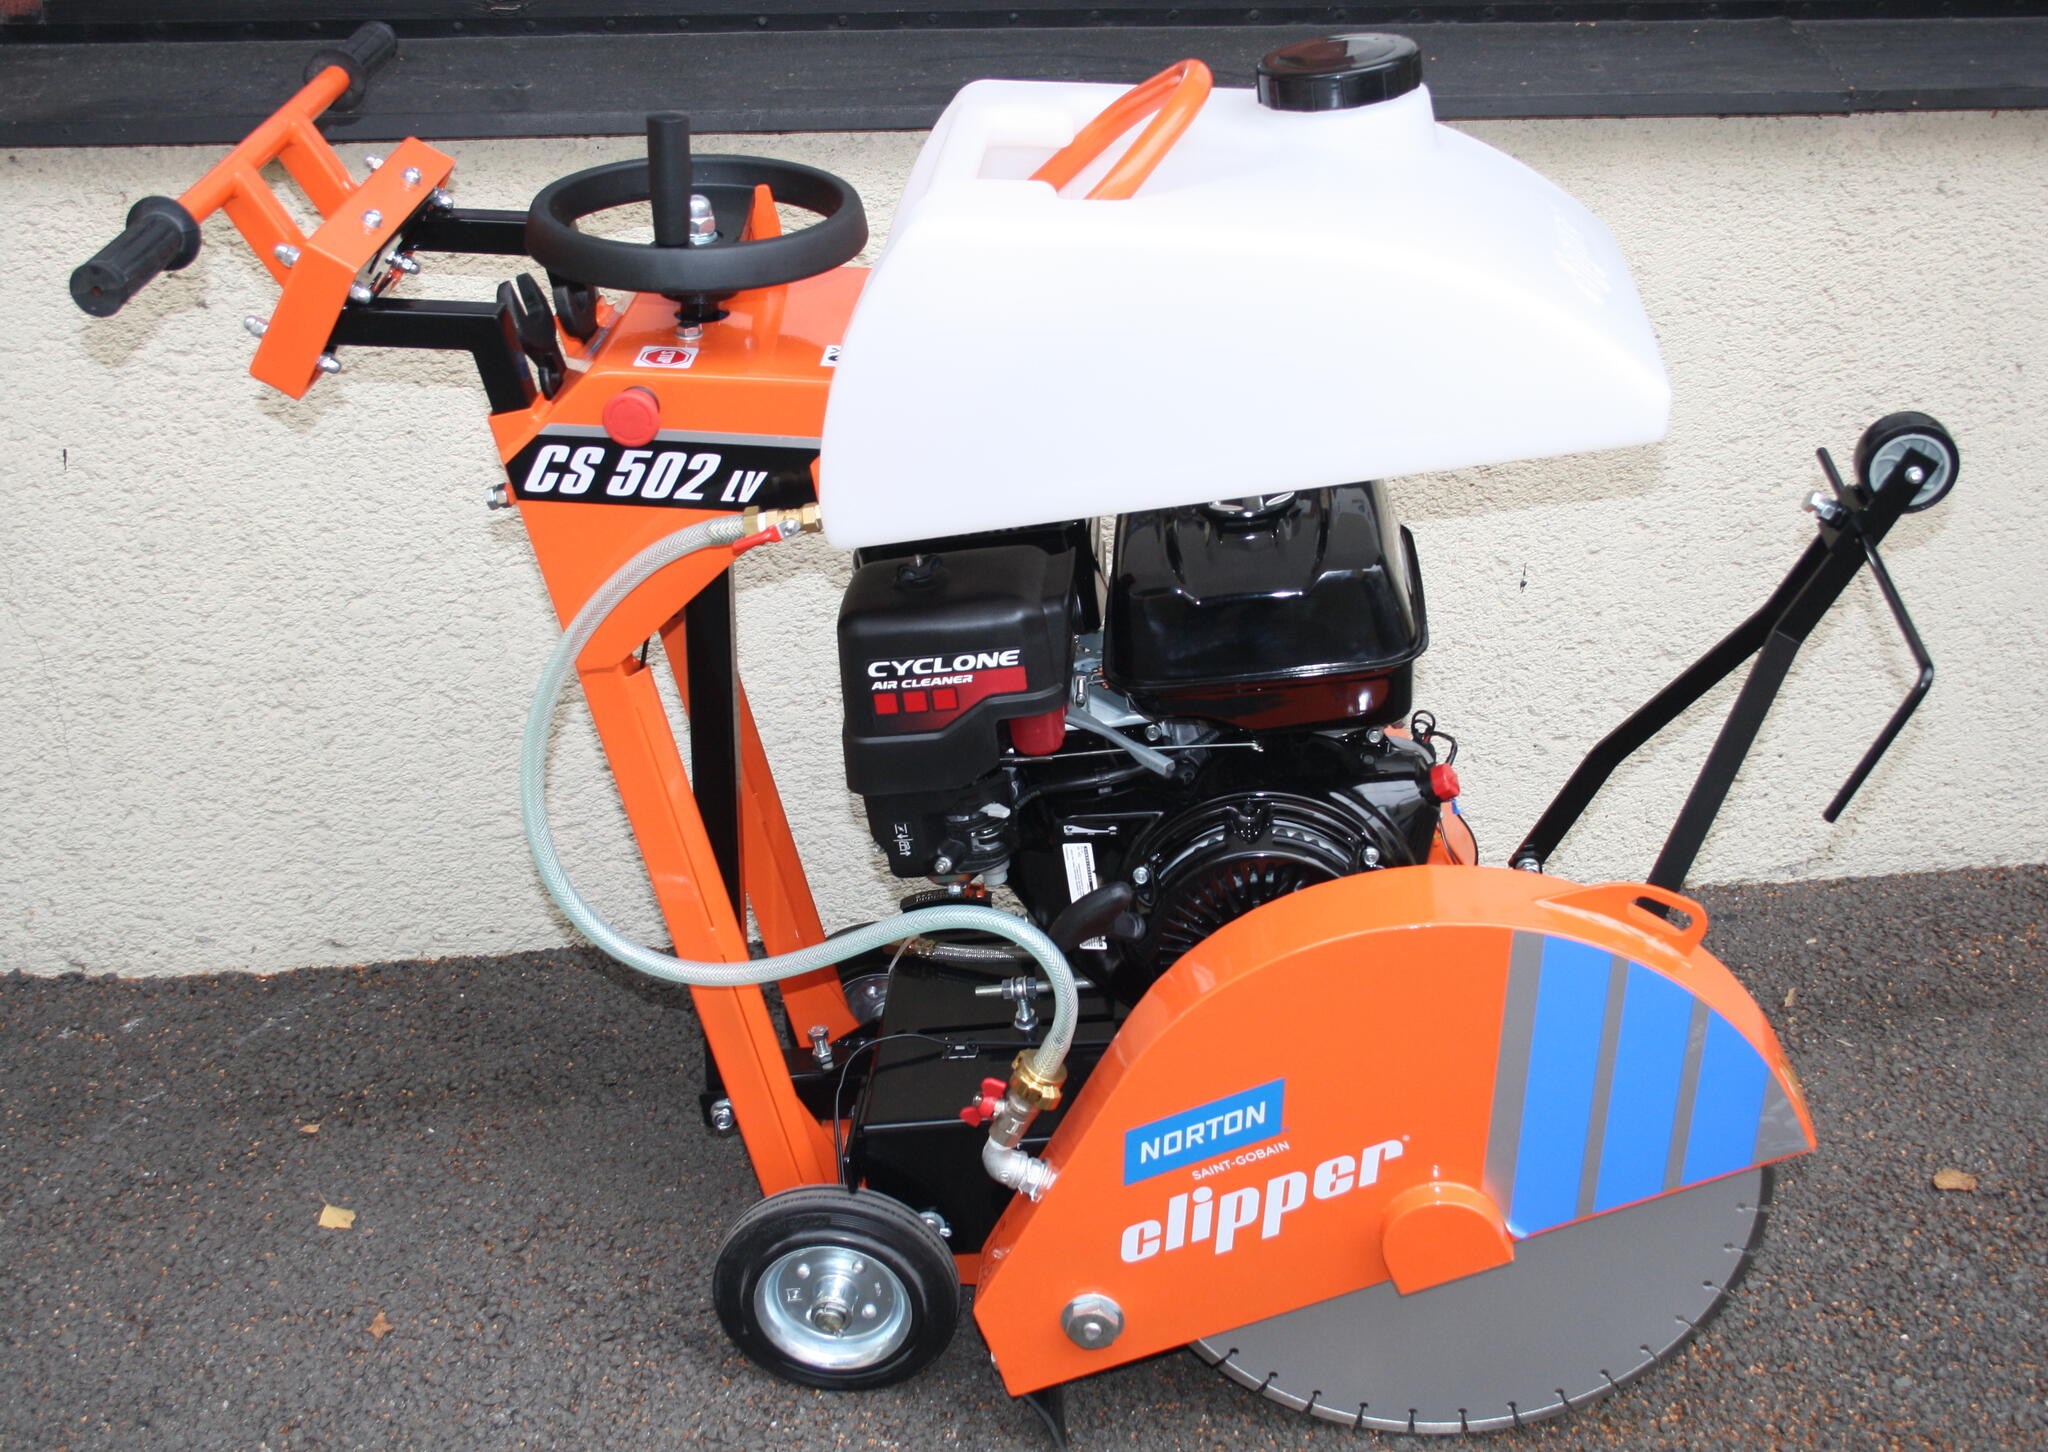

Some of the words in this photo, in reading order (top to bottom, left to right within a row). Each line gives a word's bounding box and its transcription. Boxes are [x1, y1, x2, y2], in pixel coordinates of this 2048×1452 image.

[524, 445, 605, 494] CS
[606, 450, 722, 501] 502
[720, 471, 768, 503] LV
[867, 649, 1020, 678] CYCLONE
[871, 680, 898, 690] AIR
[901, 674, 973, 688] CLEANER
[1140, 1101, 1267, 1165] NORTON
[1191, 1140, 1290, 1181] SAINT-GOBAIN
[1120, 1139, 1404, 1263] clipper
